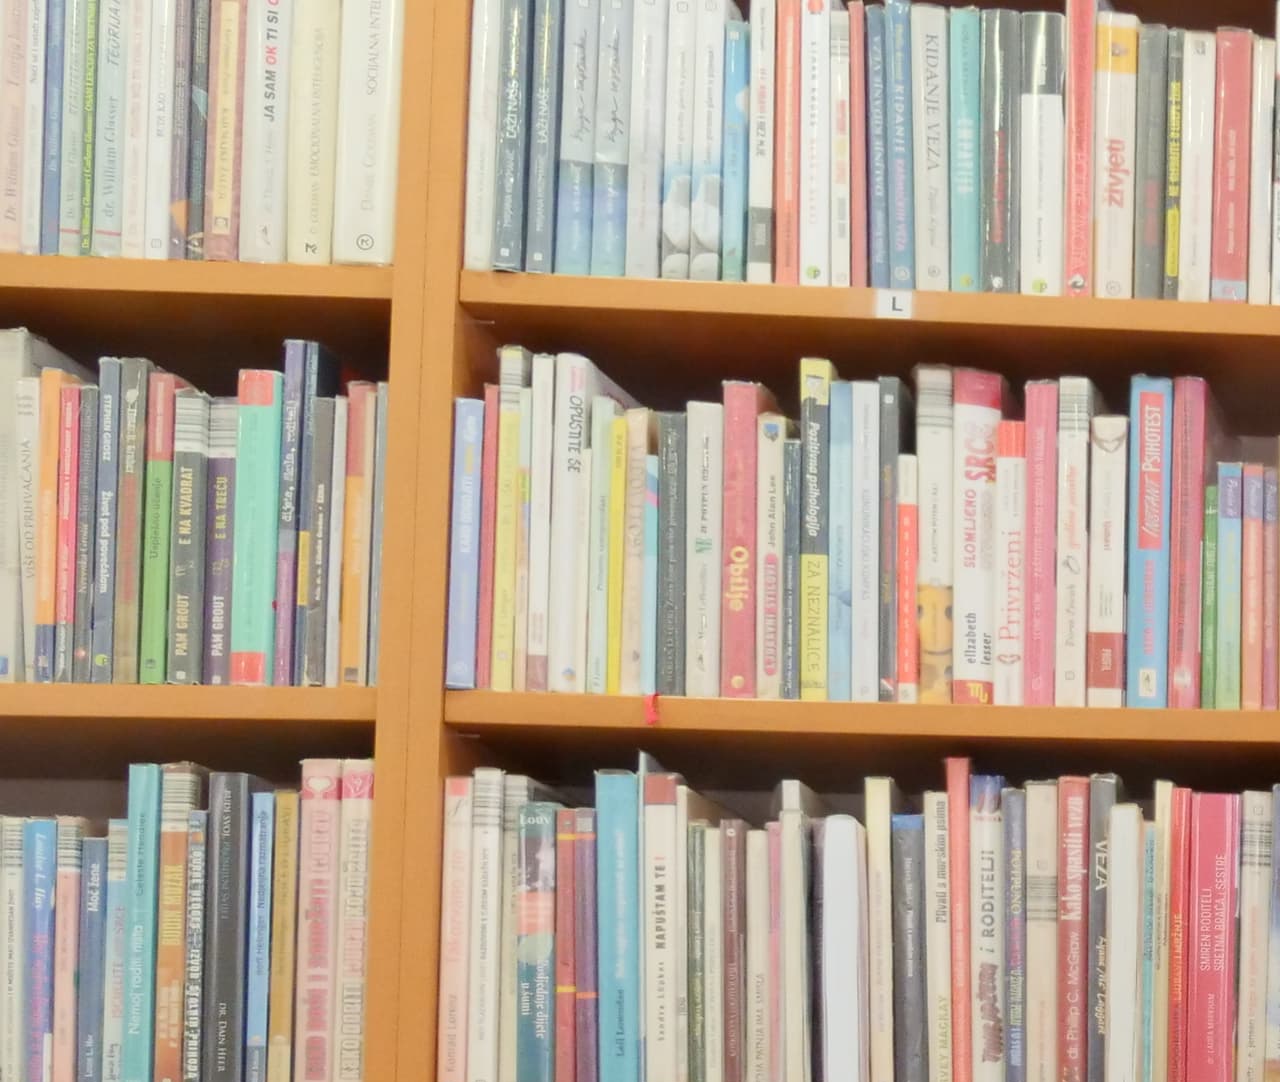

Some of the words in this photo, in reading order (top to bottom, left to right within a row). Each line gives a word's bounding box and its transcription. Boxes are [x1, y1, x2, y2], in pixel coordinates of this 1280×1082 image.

[266, 11, 278, 24] SI
[265, 27, 278, 40] TI
[265, 46, 277, 64] OK
[264, 70, 277, 100] SAM
[264, 104, 277, 122] JA
[102, 147, 117, 195] William
[102, 200, 116, 217] dr.
[892, 297, 902, 310] L
[21, 555, 35, 578] VIŠE
[997, 530, 1022, 641] Privrženi
[176, 594, 189, 627] GROUT
[213, 595, 224, 629] GROUT
[175, 631, 189, 655] PAM
[212, 632, 224, 655] PAM
[981, 850, 996, 937] RODITELJI
[444, 1034, 456, 1072] Konrad
